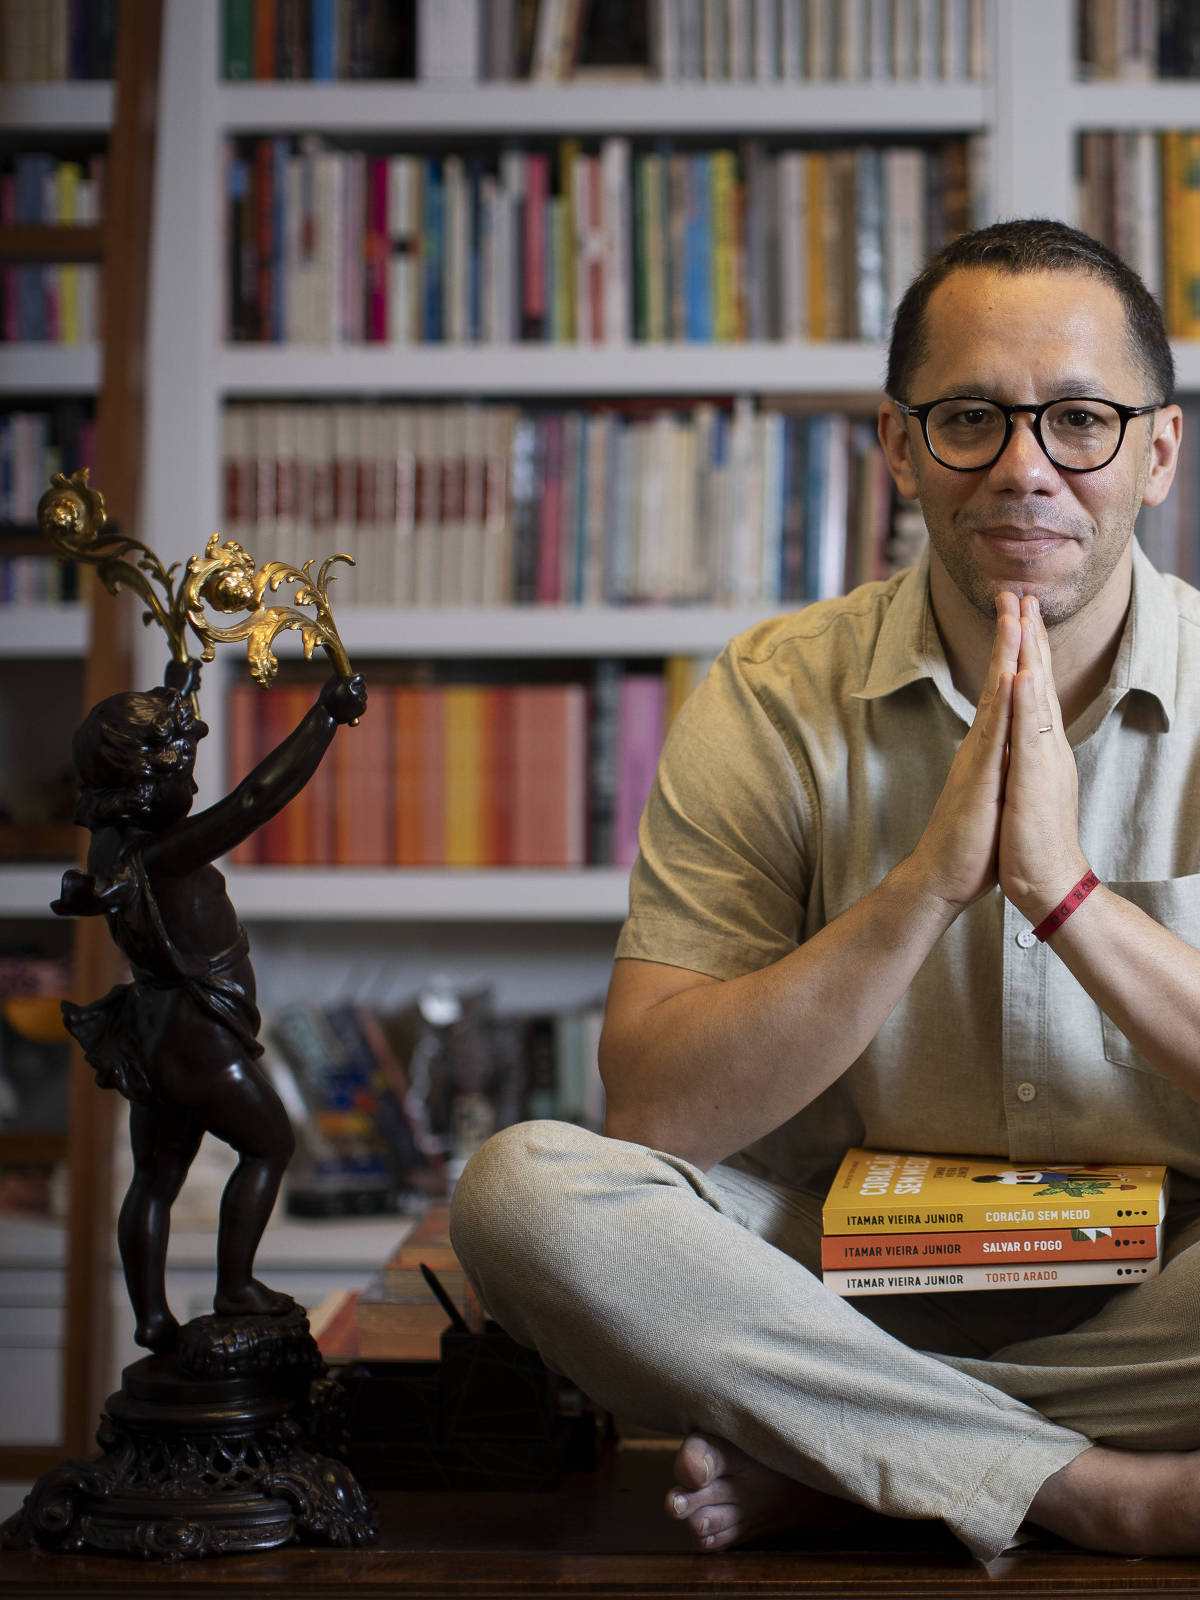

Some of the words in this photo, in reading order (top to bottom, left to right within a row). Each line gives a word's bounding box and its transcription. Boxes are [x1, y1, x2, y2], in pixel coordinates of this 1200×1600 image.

[846, 1215, 885, 1226] ITAMAR
[888, 1214, 921, 1225] VIEIRA
[924, 1213, 964, 1224] JUNIOR
[985, 1209, 1034, 1224] CORAÇÃO
[1038, 1210, 1059, 1221] SEM
[1061, 1209, 1091, 1220] MEDO
[844, 1246, 882, 1258] ITAMAR
[885, 1245, 919, 1256] VIEIRA
[922, 1244, 961, 1255] JUNIOR
[982, 1241, 1021, 1253] SALVAR
[1023, 1241, 1031, 1252] O
[1034, 1240, 1063, 1251] FOGO
[846, 1278, 885, 1288] ITAMAR
[888, 1276, 921, 1287] VIEIRA
[924, 1275, 964, 1286] JUNIOR
[985, 1272, 1020, 1283] TORTO
[1023, 1270, 1058, 1282] ARADO
